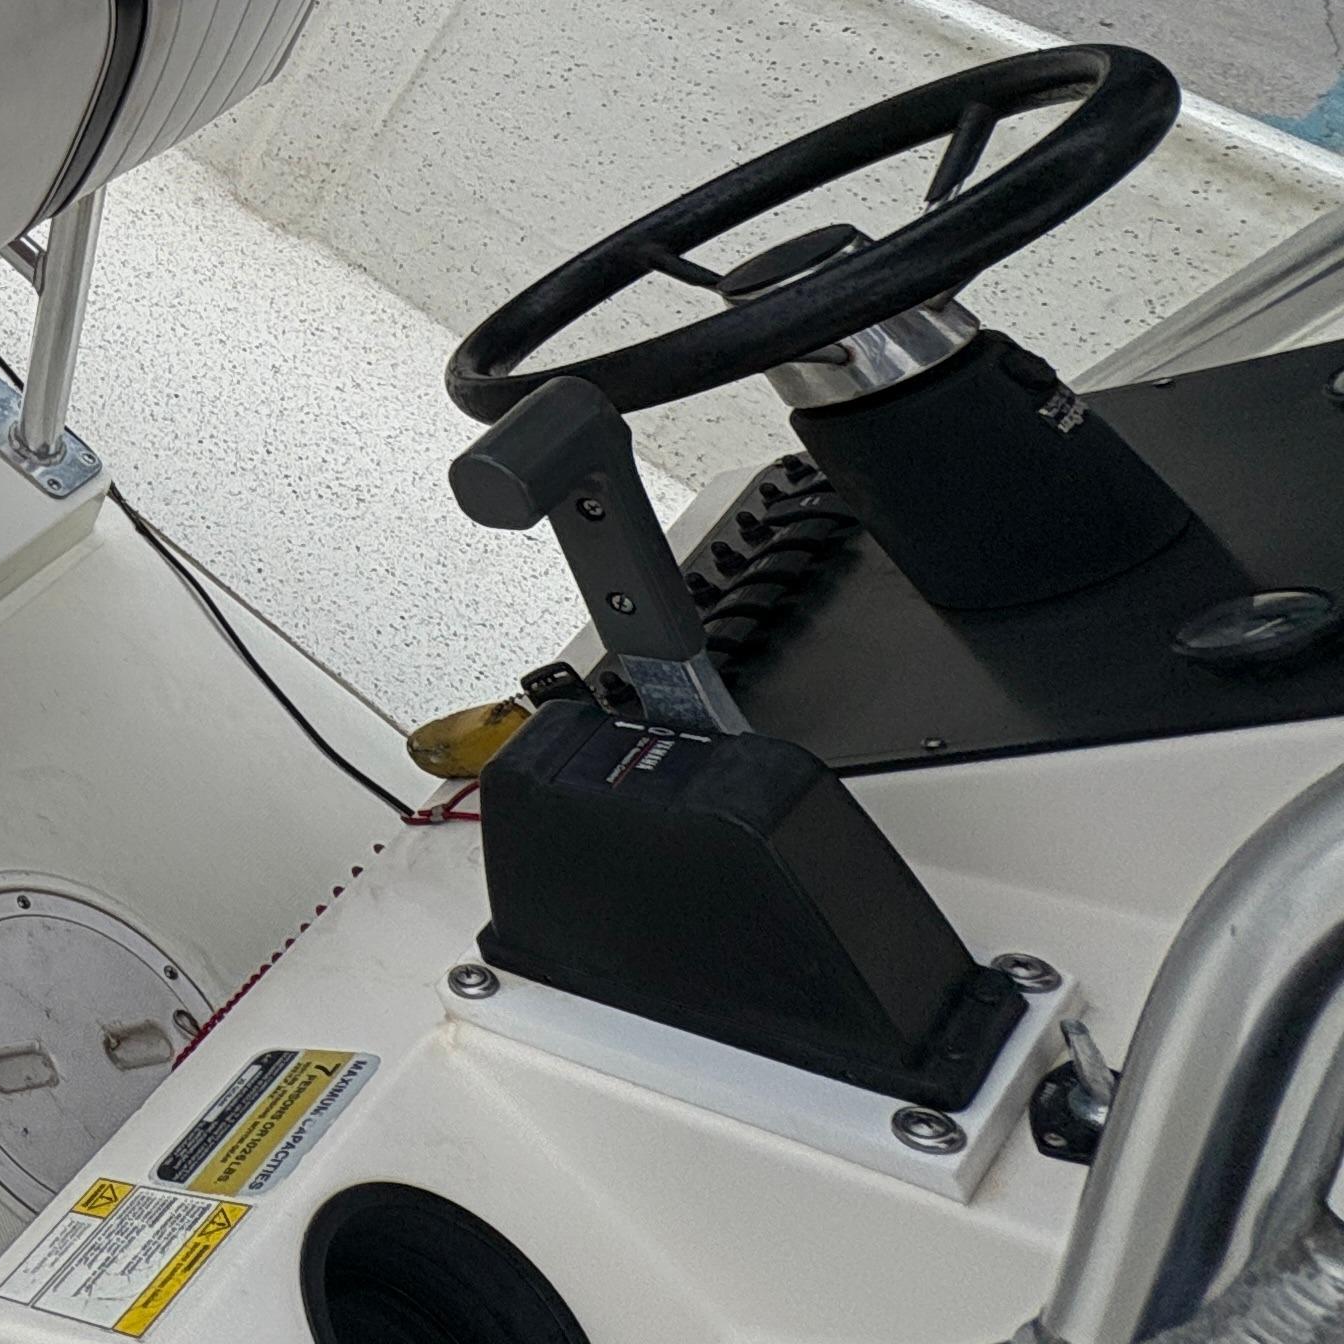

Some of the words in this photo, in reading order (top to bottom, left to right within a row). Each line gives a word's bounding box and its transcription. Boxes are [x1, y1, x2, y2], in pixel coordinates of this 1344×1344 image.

[314, 1062, 342, 1079] 7
[270, 1074, 317, 1121] PERSONS
[255, 1121, 276, 1137] OR
